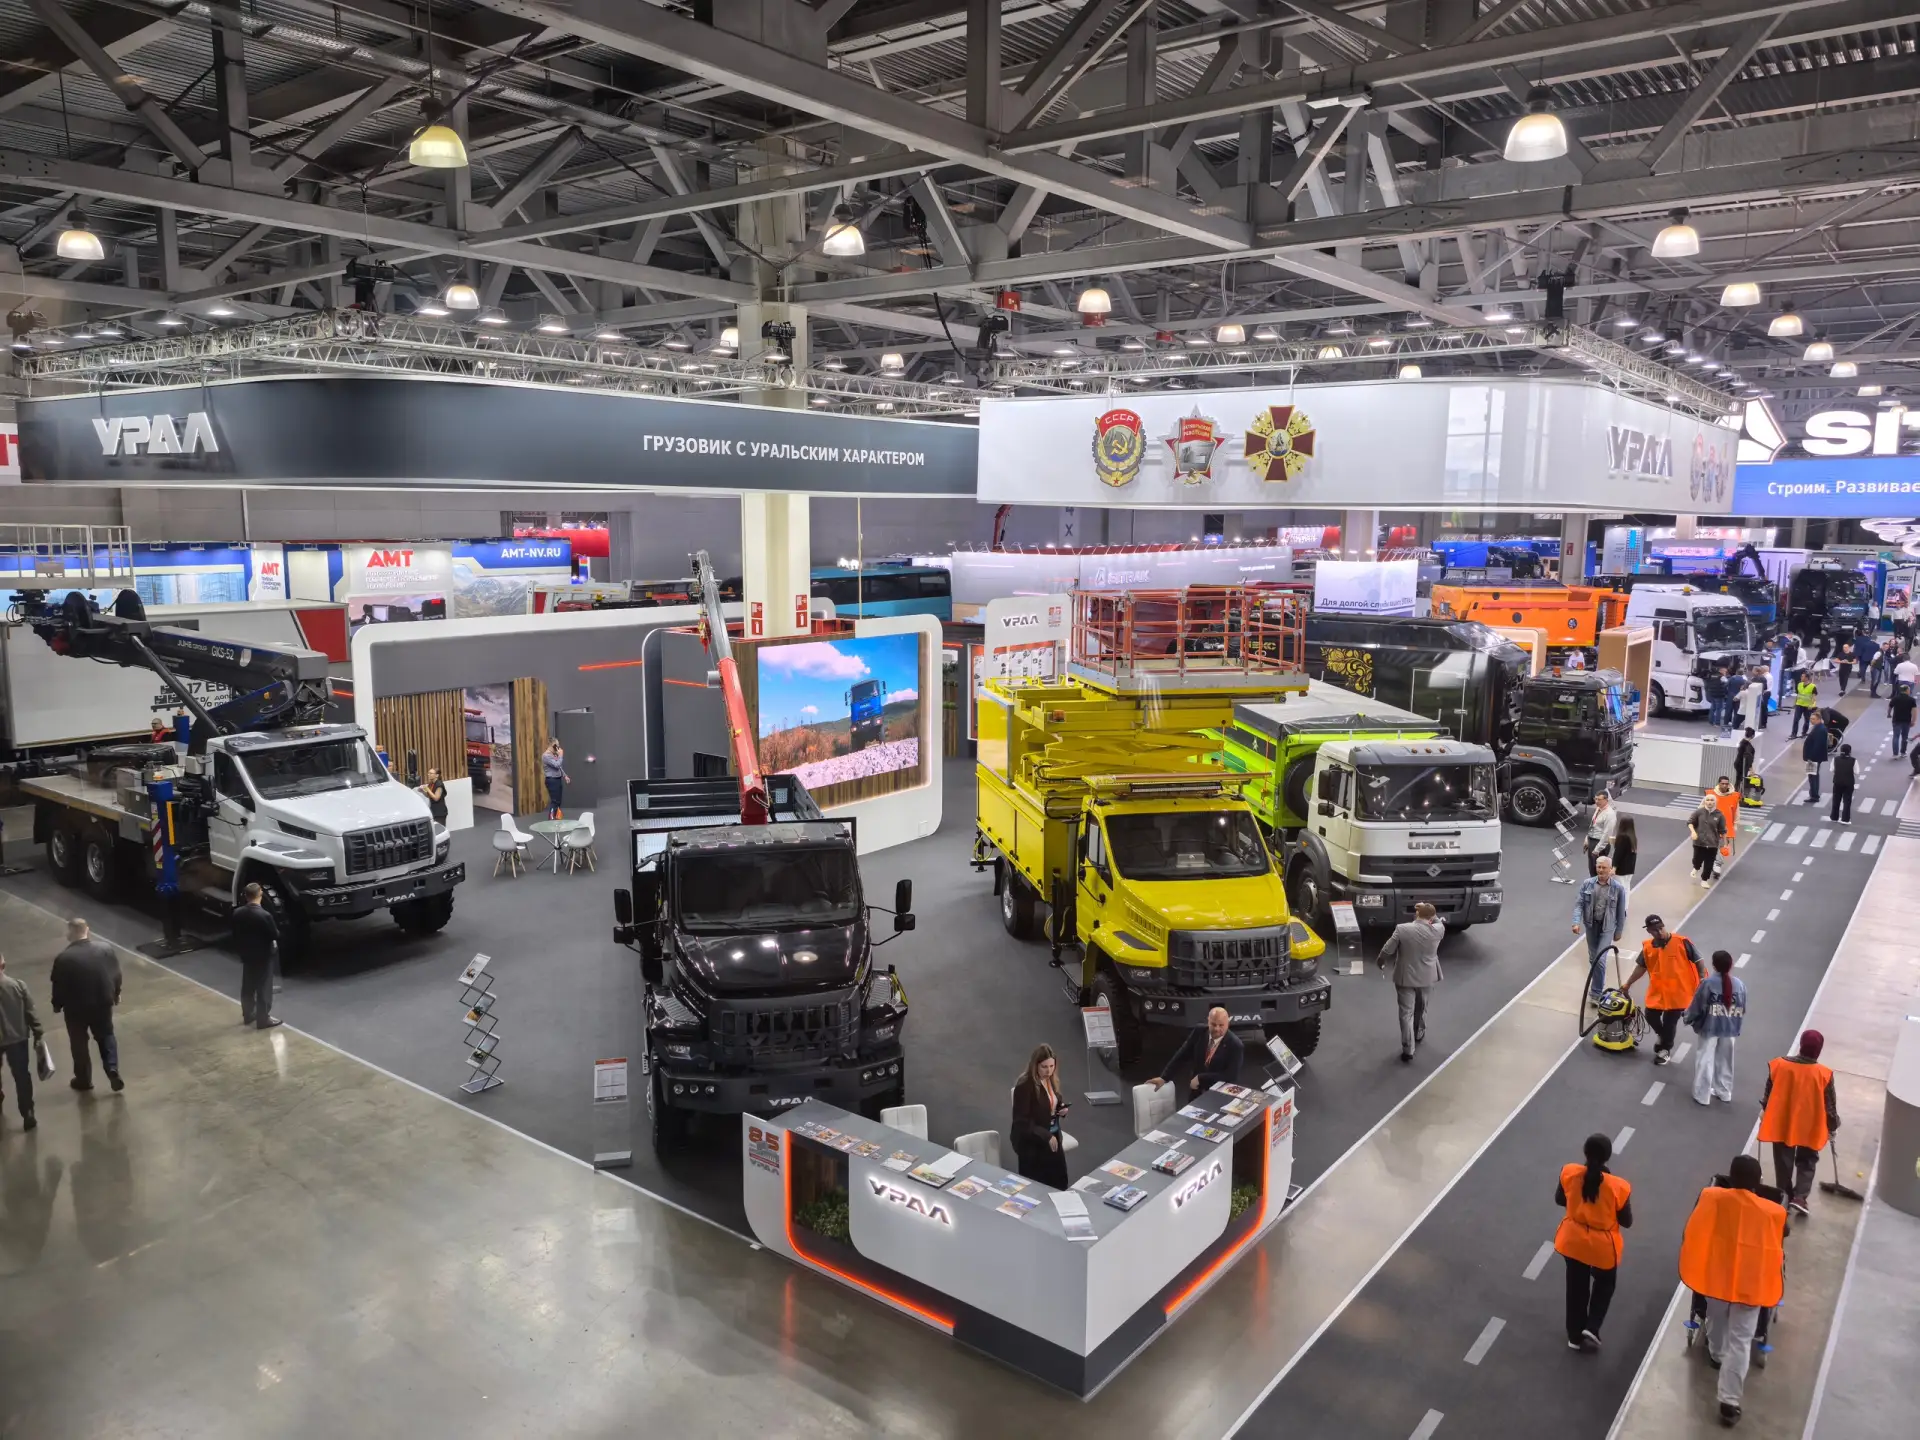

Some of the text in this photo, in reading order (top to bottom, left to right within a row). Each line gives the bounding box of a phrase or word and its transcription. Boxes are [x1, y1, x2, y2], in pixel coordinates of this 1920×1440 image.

[1105, 413, 1134, 424] СССР
[93, 412, 219, 455] УРАЛ
[643, 435, 925, 466] ГРУЗОВИК С УРАЛЬСКИМ ХАРАКТЕРОМ
[1607, 425, 1673, 477] УРАЛ
[1767, 481, 1830, 497] Строим.
[366, 550, 413, 568] AMT
[501, 547, 561, 558] AMT-NV.RU
[261, 562, 279, 576] AMT
[1321, 598, 1338, 606] Для
[1339, 598, 1368, 608] долгой
[1003, 615, 1039, 627] УРАЛ
[187, 682, 201, 693] 17
[1408, 841, 1460, 849] URAL
[386, 892, 415, 903] УРАЛ
[1273, 1098, 1292, 1126] 85
[749, 1126, 779, 1152] 85
[1174, 1161, 1223, 1209] УРАЛ
[868, 1178, 953, 1225] УРАЛ
